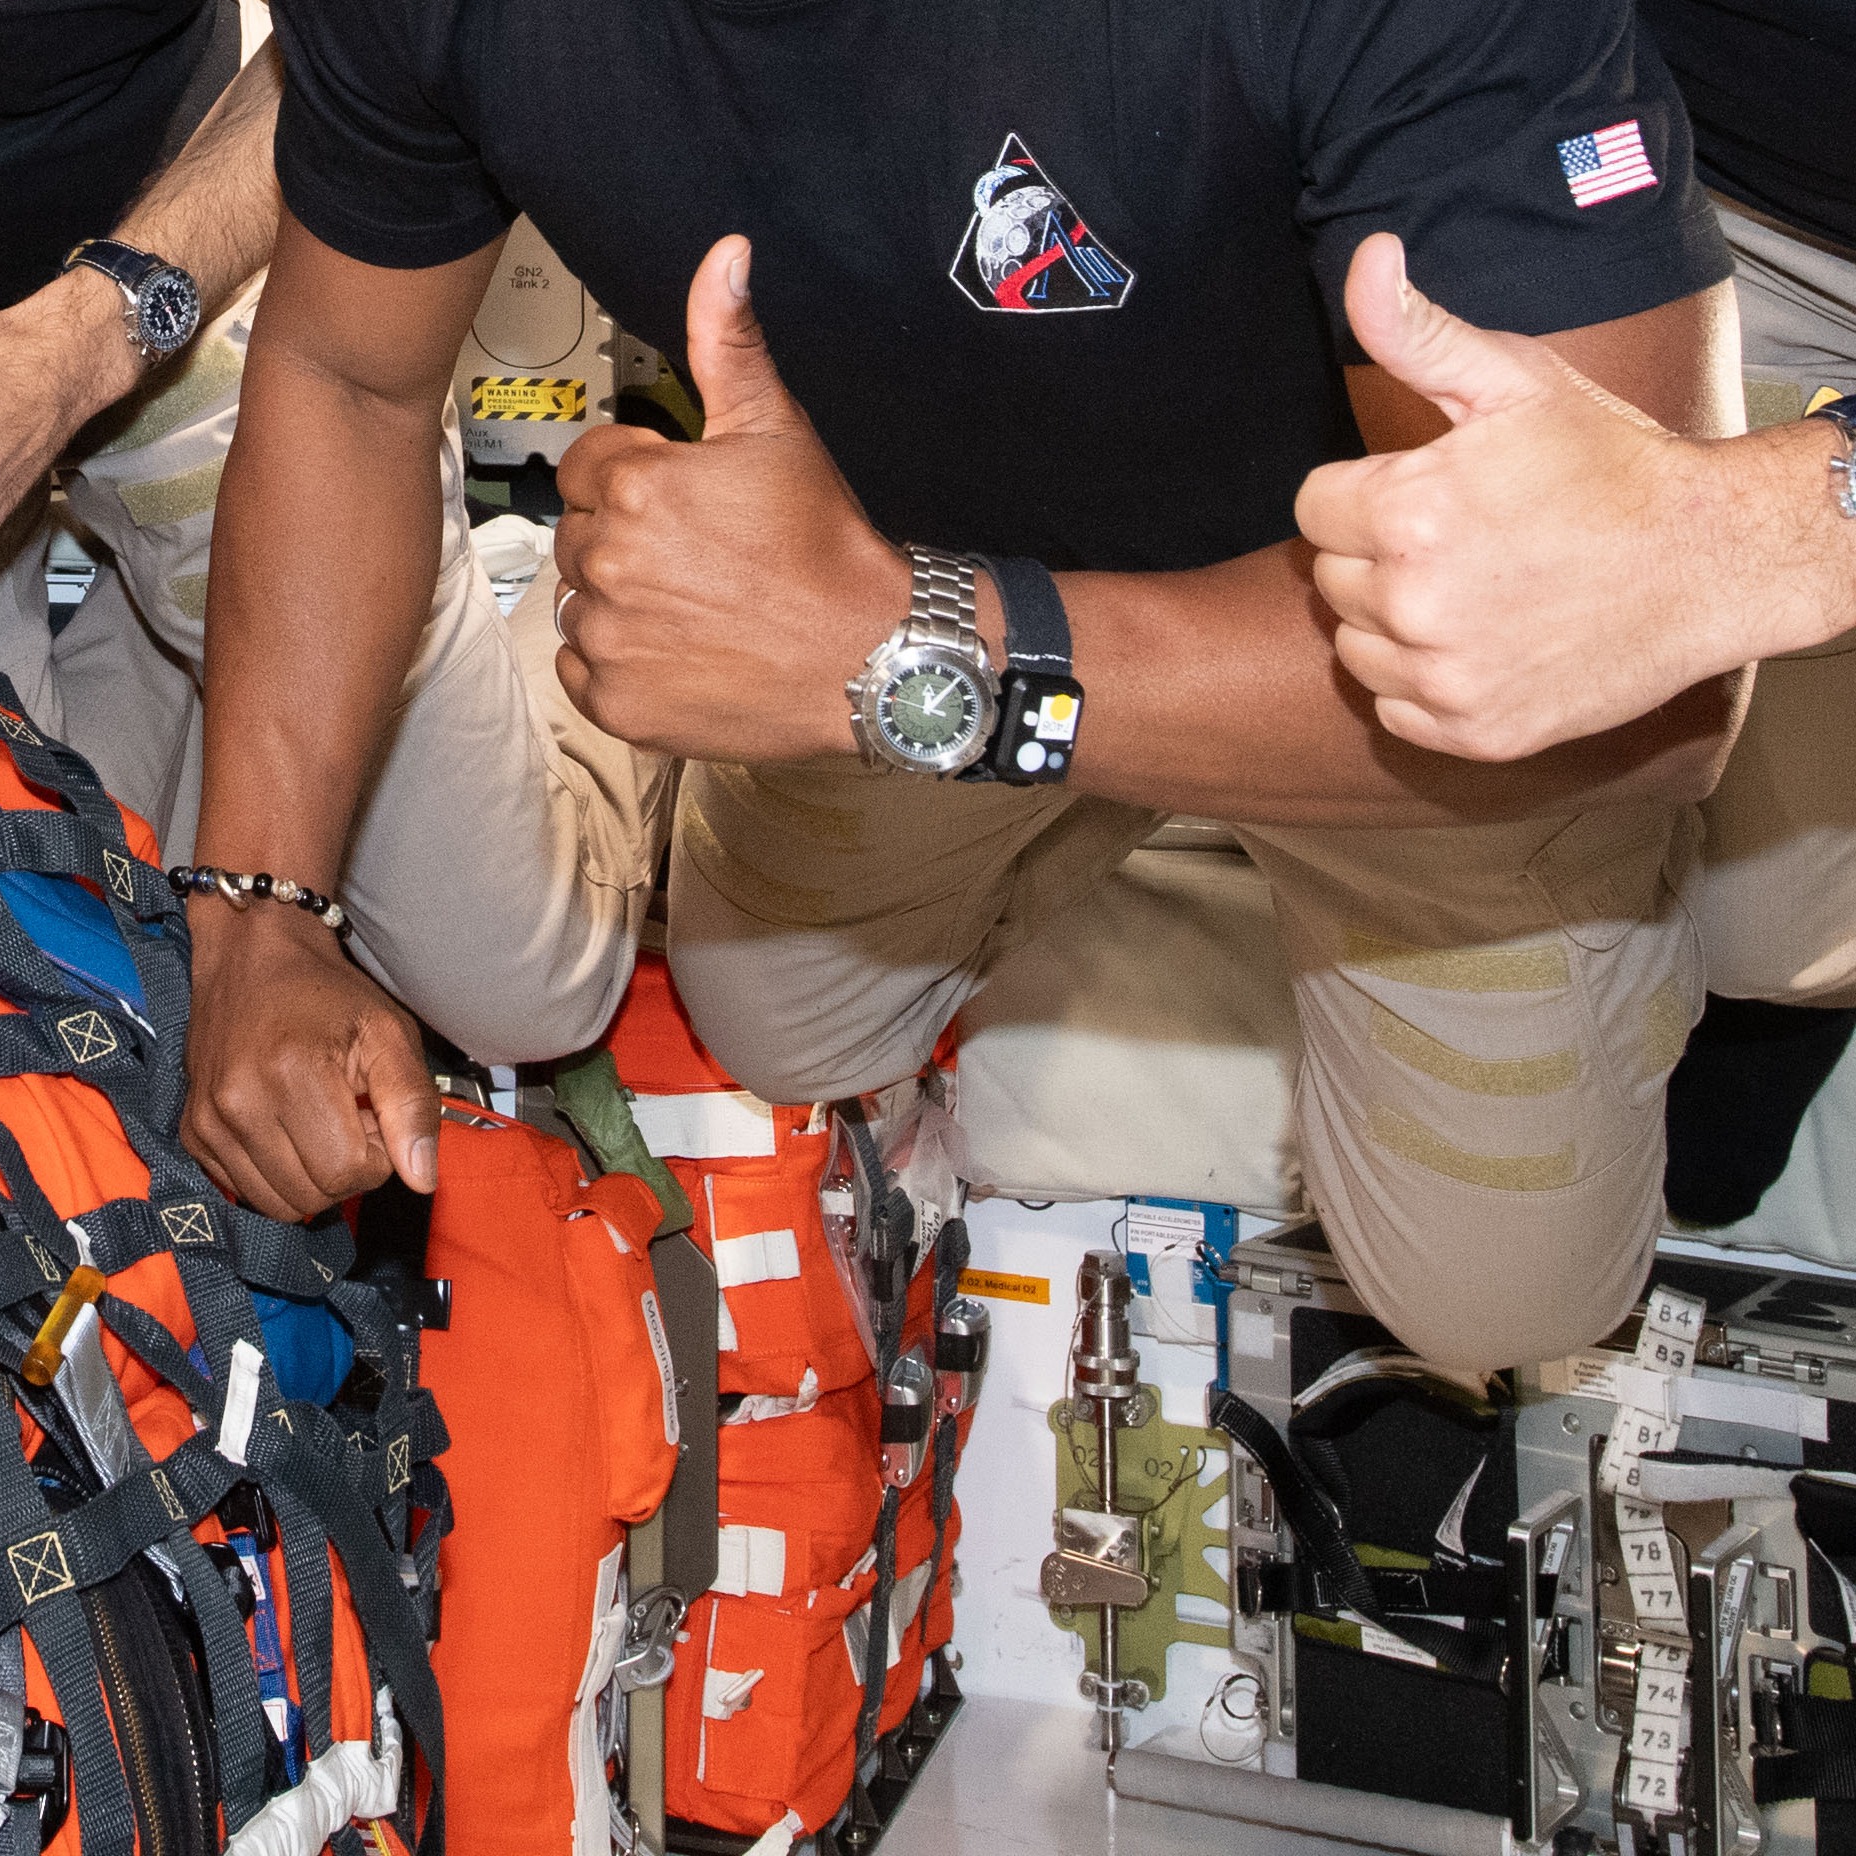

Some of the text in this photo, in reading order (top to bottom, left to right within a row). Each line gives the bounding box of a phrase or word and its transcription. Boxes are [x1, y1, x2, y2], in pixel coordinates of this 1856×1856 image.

[514, 265, 543, 278] GN2
[509, 278, 550, 290] Tank 2
[487, 389, 537, 398] WARNING
[465, 427, 489, 437] Aux
[985, 1280, 1021, 1292] Medical
[1659, 1304, 1692, 1327] 84
[646, 1300, 671, 1383] Mooring
[1655, 1344, 1686, 1368] 83
[1638, 1426, 1662, 1449] 81
[1626, 1467, 1641, 1487] 8
[1630, 1541, 1662, 1562] 78
[1640, 1590, 1673, 1608] 77
[1646, 1684, 1678, 1703] 74
[1641, 1728, 1672, 1749] 73
[1637, 1774, 1668, 1797] 72
